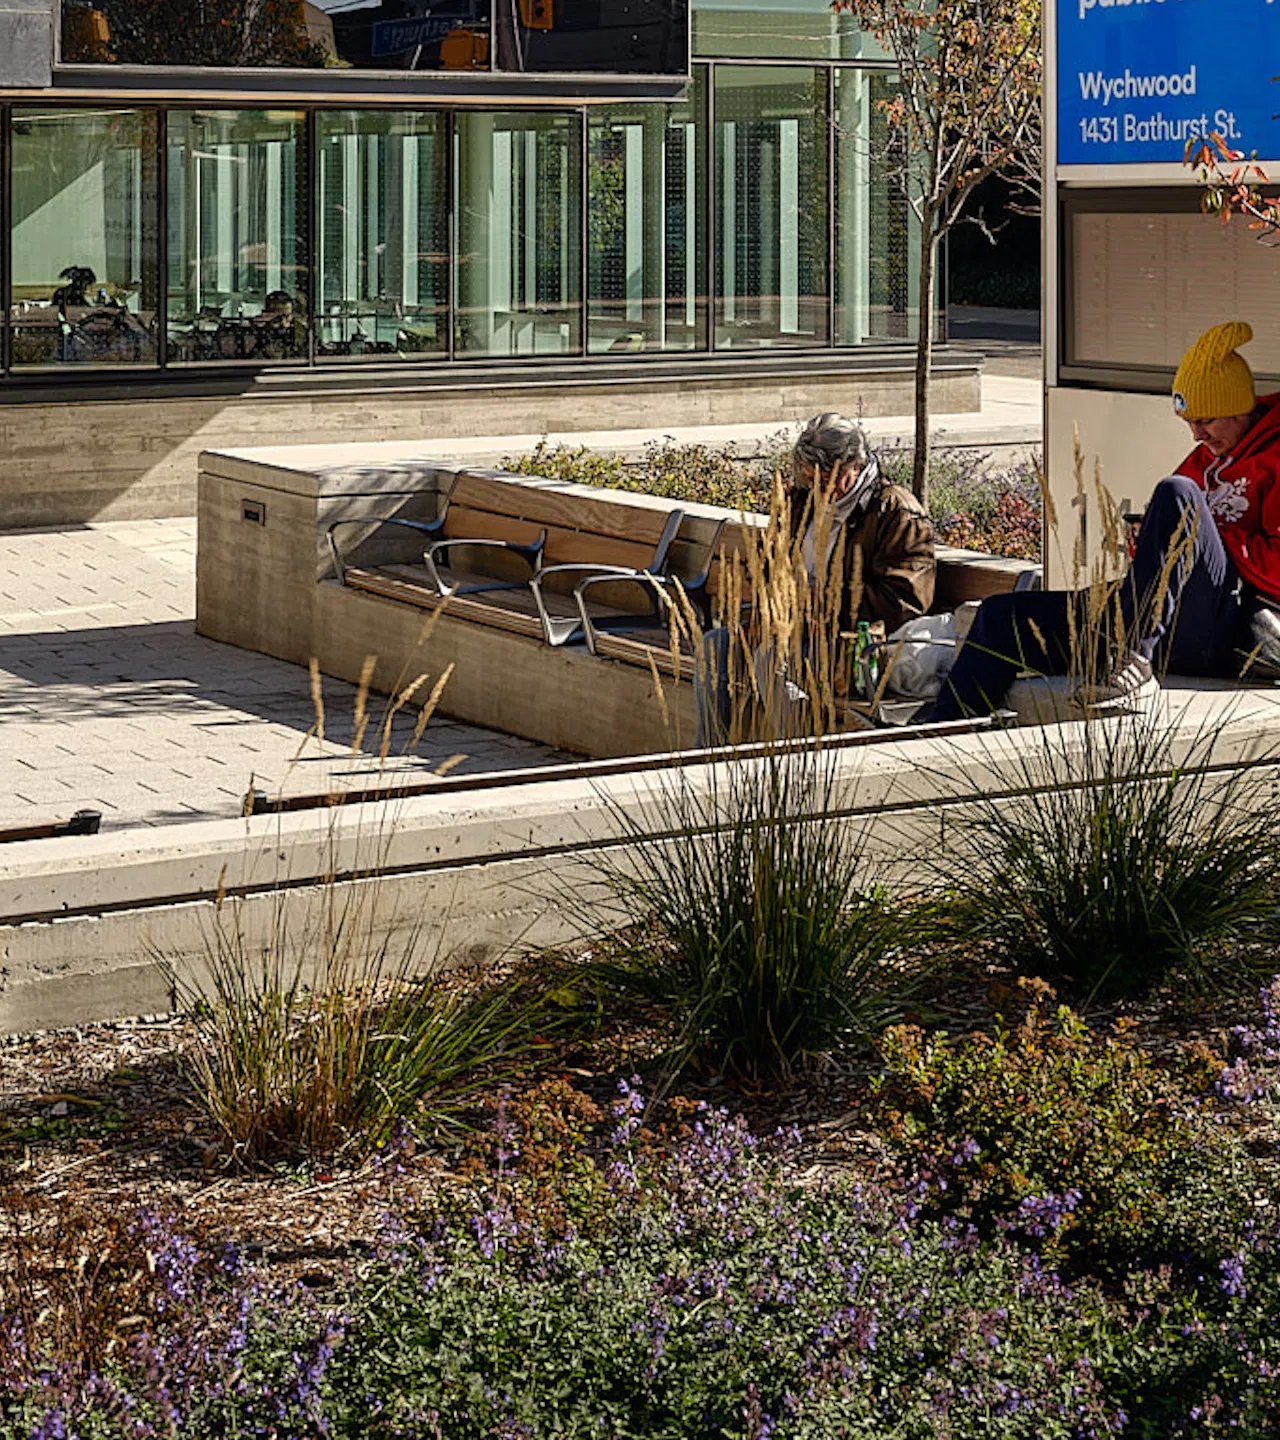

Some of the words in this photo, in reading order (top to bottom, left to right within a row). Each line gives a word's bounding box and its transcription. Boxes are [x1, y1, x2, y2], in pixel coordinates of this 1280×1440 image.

[1078, 64, 1197, 106] Wychwood
[1079, 117, 1119, 143] 1431
[1124, 112, 1209, 142] Bathurst
[1213, 109, 1242, 139] St.
